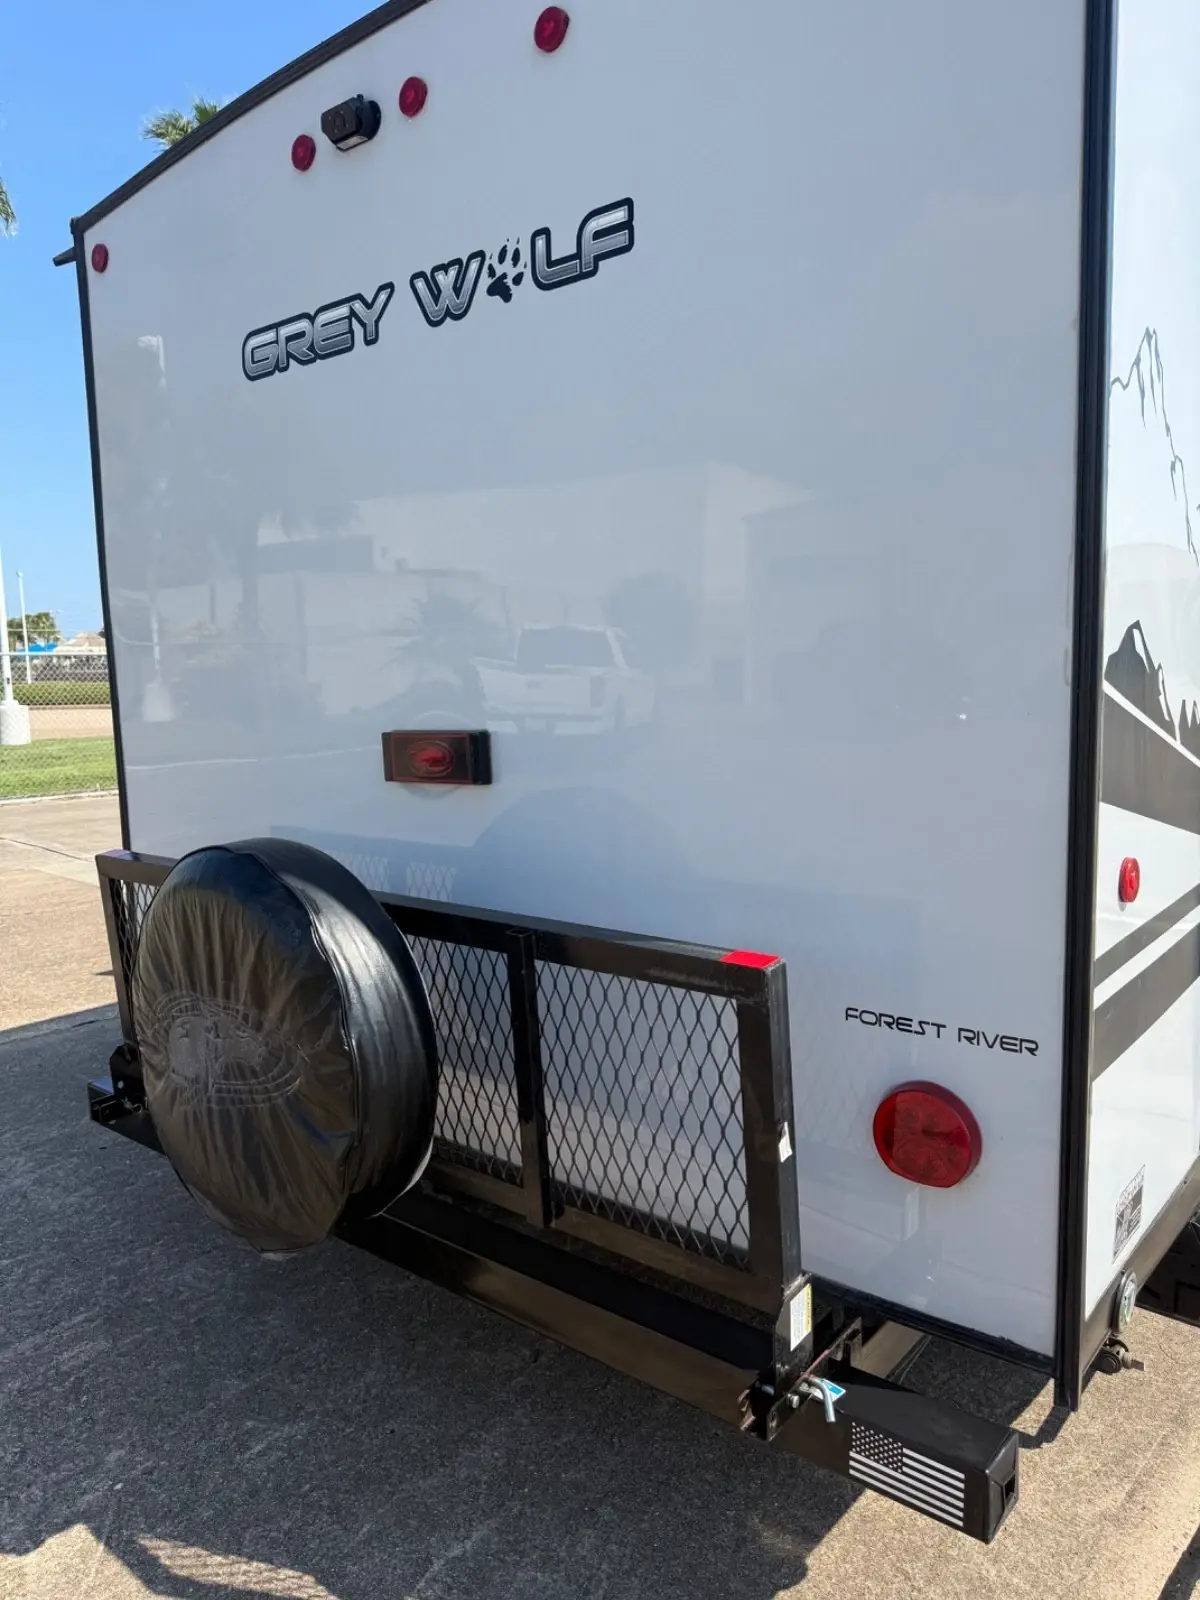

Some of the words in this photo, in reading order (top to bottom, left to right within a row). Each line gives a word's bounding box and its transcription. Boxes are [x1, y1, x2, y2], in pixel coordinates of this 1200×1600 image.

[242, 282, 395, 381] GREY
[410, 197, 634, 327] WLF
[845, 1007, 947, 1039] FOREST
[957, 1027, 1040, 1056] RIVER
